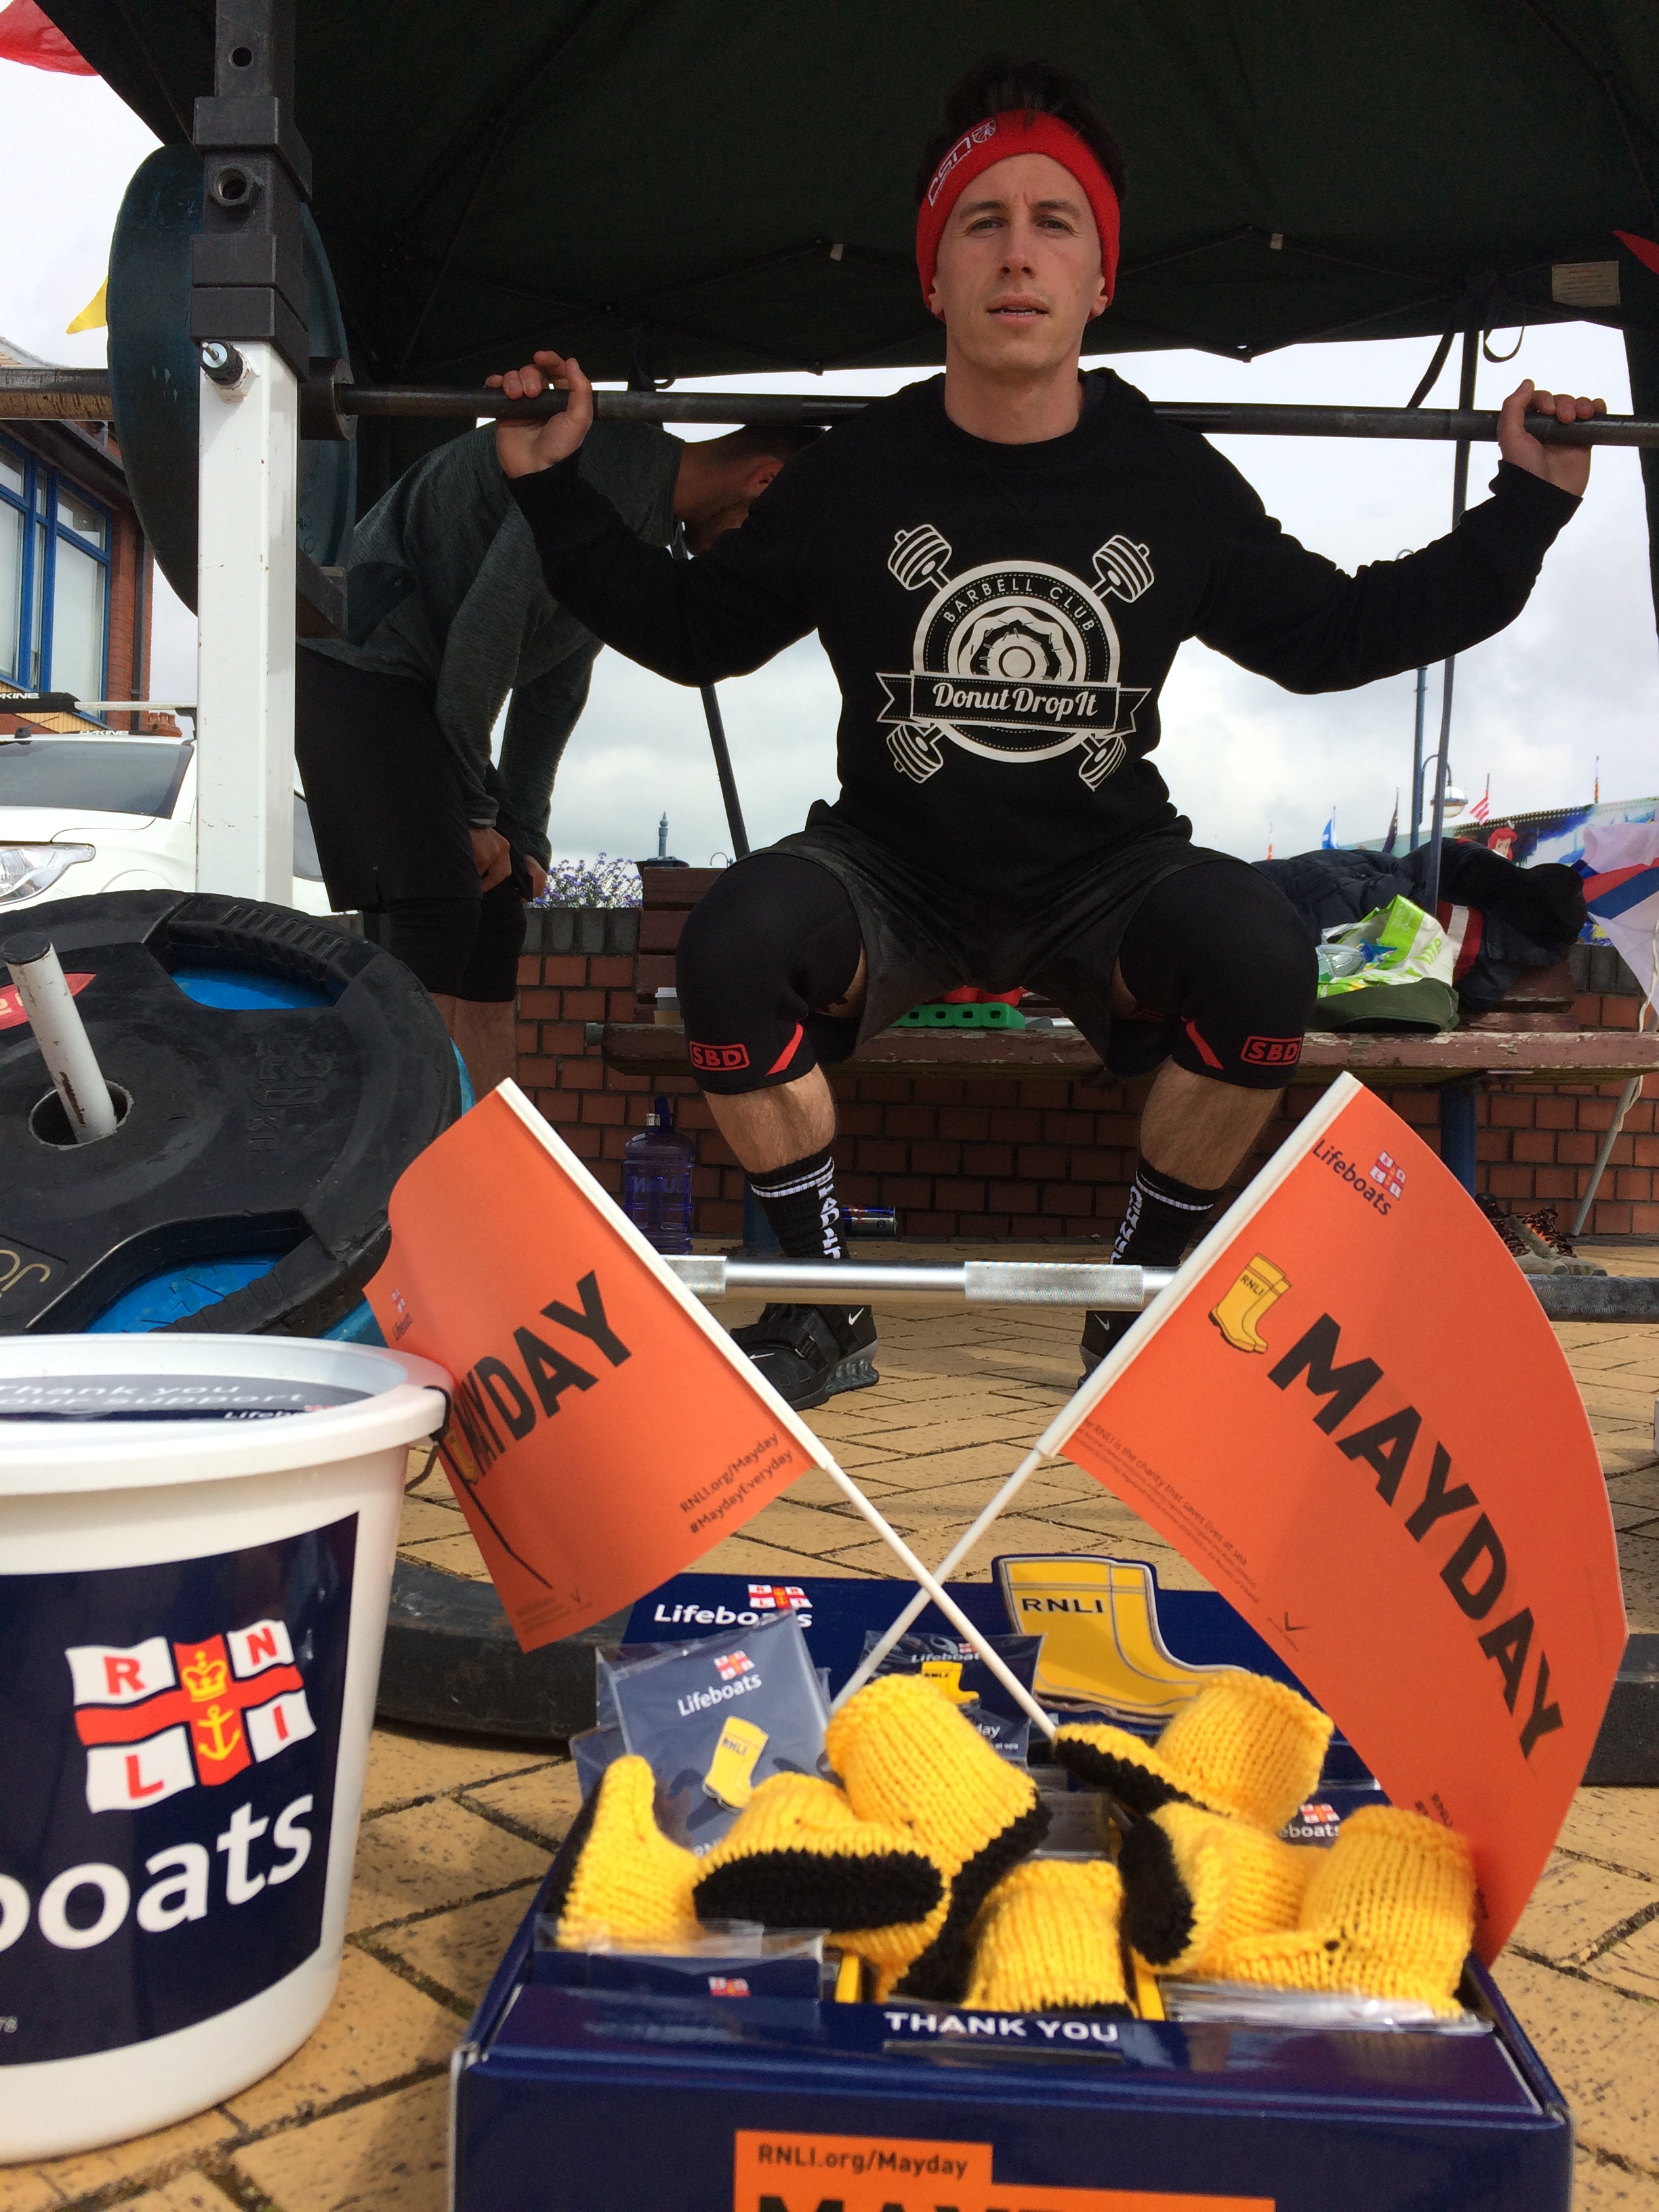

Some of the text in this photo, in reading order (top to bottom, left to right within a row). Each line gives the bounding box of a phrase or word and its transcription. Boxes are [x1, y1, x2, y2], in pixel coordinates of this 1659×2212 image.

[943, 579, 1095, 632] BARBELL CLUB
[933, 682, 1011, 710] Donut
[693, 1046, 742, 1066] SBD
[1248, 1042, 1299, 1061] SBD
[1312, 1139, 1392, 1216] Lifeboats
[1240, 1273, 1265, 1296] RNLI
[103, 1393, 304, 1406] support
[152, 1386, 240, 1397] you
[1267, 1312, 1563, 1761] MAYDAY
[654, 1603, 813, 1628] Lifebos
[1021, 1597, 1104, 1614] RNLI
[103, 1626, 279, 1695] R N
[911, 1652, 981, 1663] Lifeboat
[678, 1673, 762, 1717] Lifeboats
[125, 1704, 290, 1801] L I
[884, 2011, 1119, 2041] THANK YOU
[758, 2143, 968, 2179] RNLI.org/Mayday
